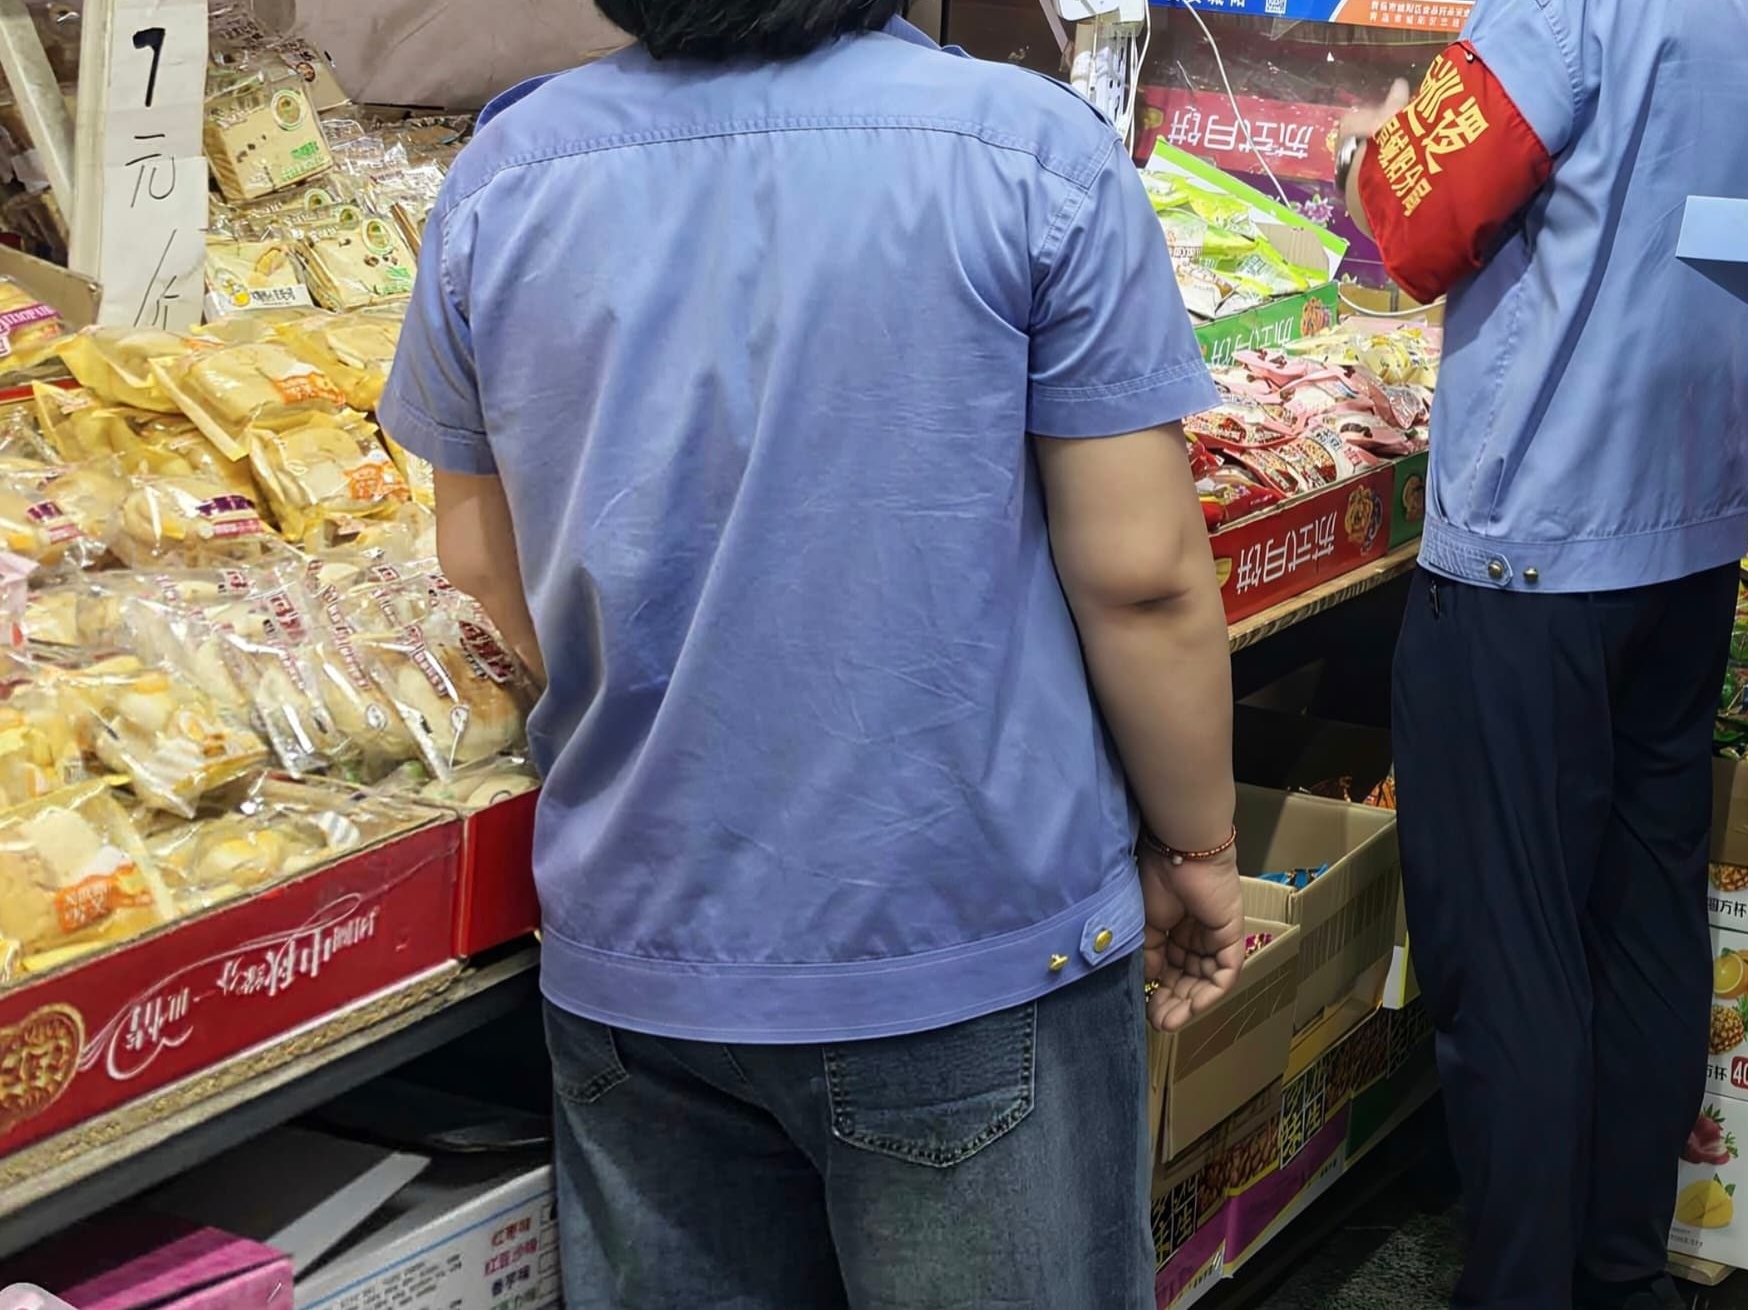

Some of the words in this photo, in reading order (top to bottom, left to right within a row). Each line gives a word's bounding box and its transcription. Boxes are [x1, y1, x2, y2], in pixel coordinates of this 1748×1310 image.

[1168, 109, 1314, 159] 苏式月饼
[1236, 511, 1338, 595] 苏式月饼
